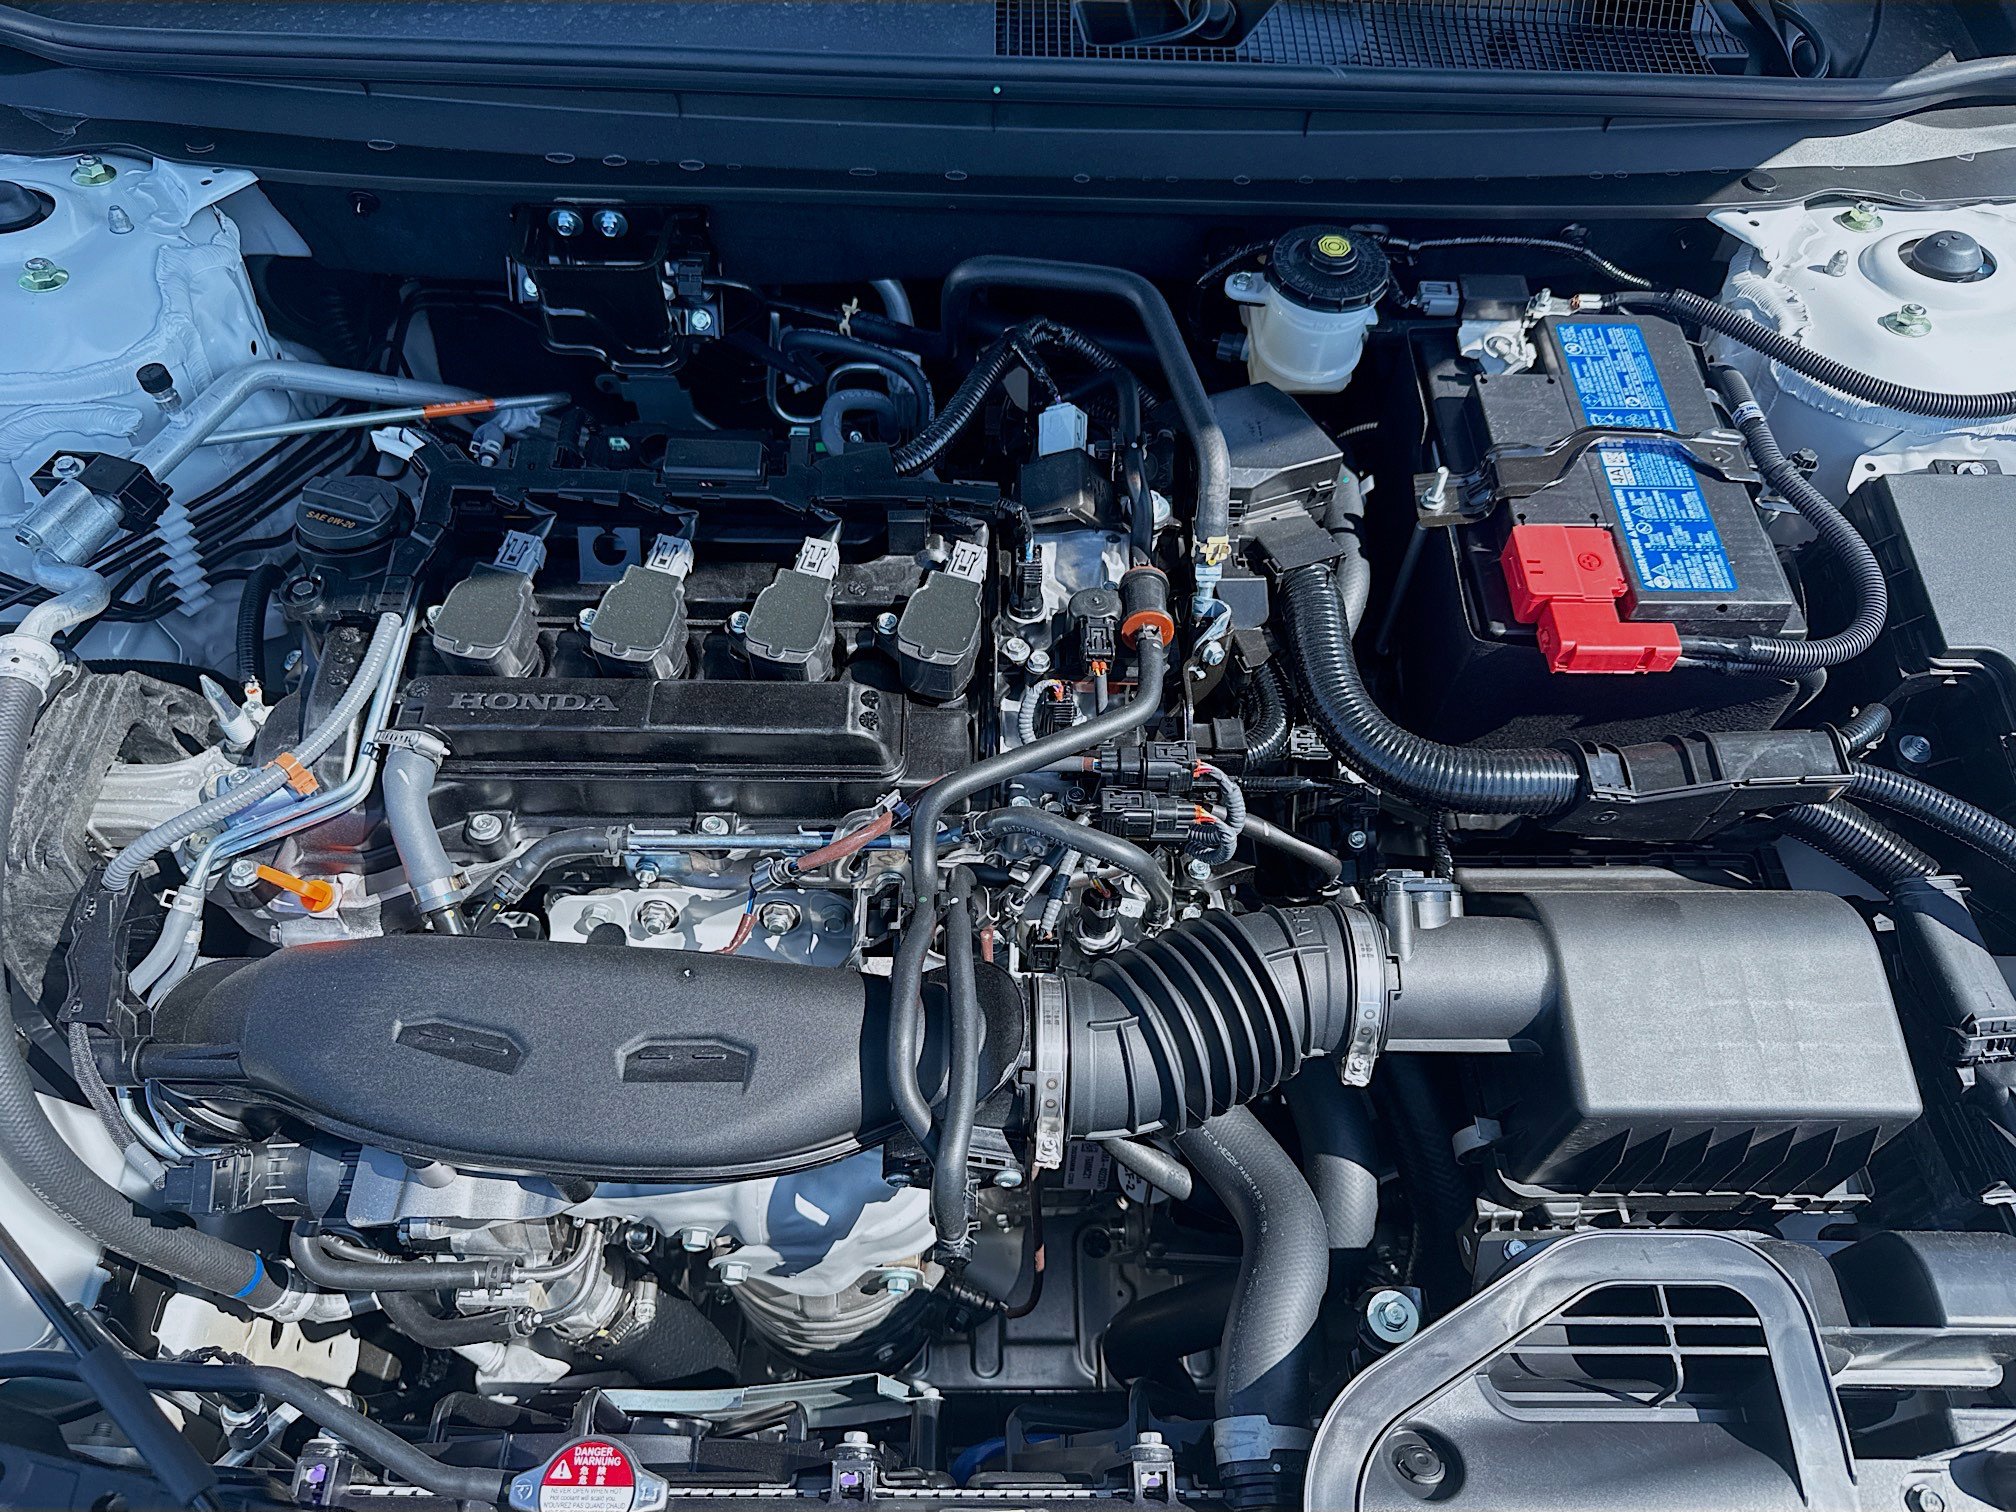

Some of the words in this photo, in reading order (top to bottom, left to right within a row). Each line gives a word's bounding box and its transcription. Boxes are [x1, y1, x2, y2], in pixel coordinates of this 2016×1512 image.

[306, 511, 327, 522] SAE
[326, 516, 356, 529] 0W-20
[447, 692, 619, 712] HONDA
[574, 1446, 614, 1457] DANGER
[573, 1456, 622, 1468] WARNUNG
